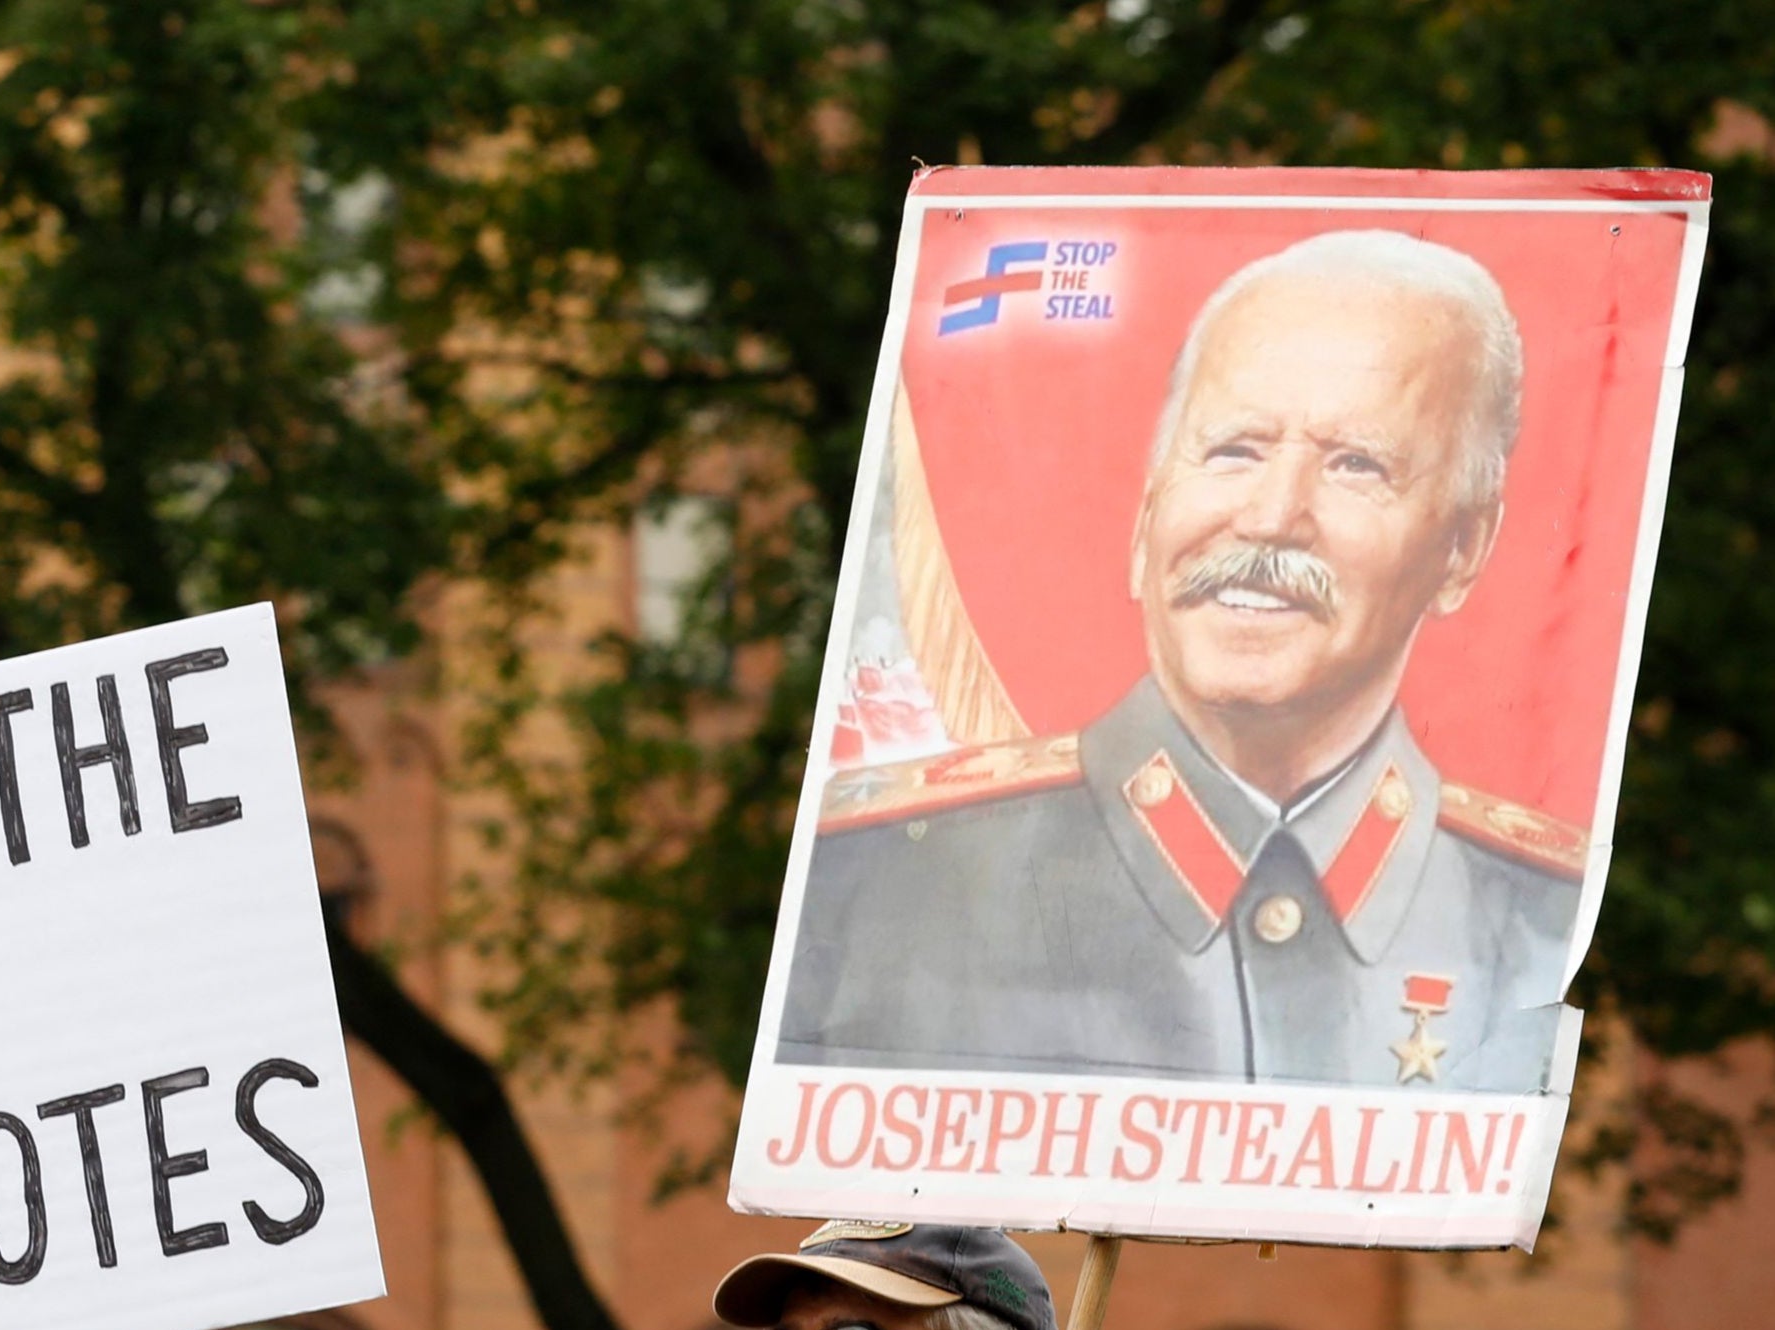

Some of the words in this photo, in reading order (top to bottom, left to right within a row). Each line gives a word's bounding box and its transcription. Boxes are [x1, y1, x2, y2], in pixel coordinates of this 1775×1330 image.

[1054, 242, 1117, 266] STOP
[1051, 271, 1089, 290] THE
[1045, 296, 1113, 319] STEAL
[767, 1081, 1103, 1178] JOSEPH
[1112, 1094, 1526, 1195] STEALIN!
